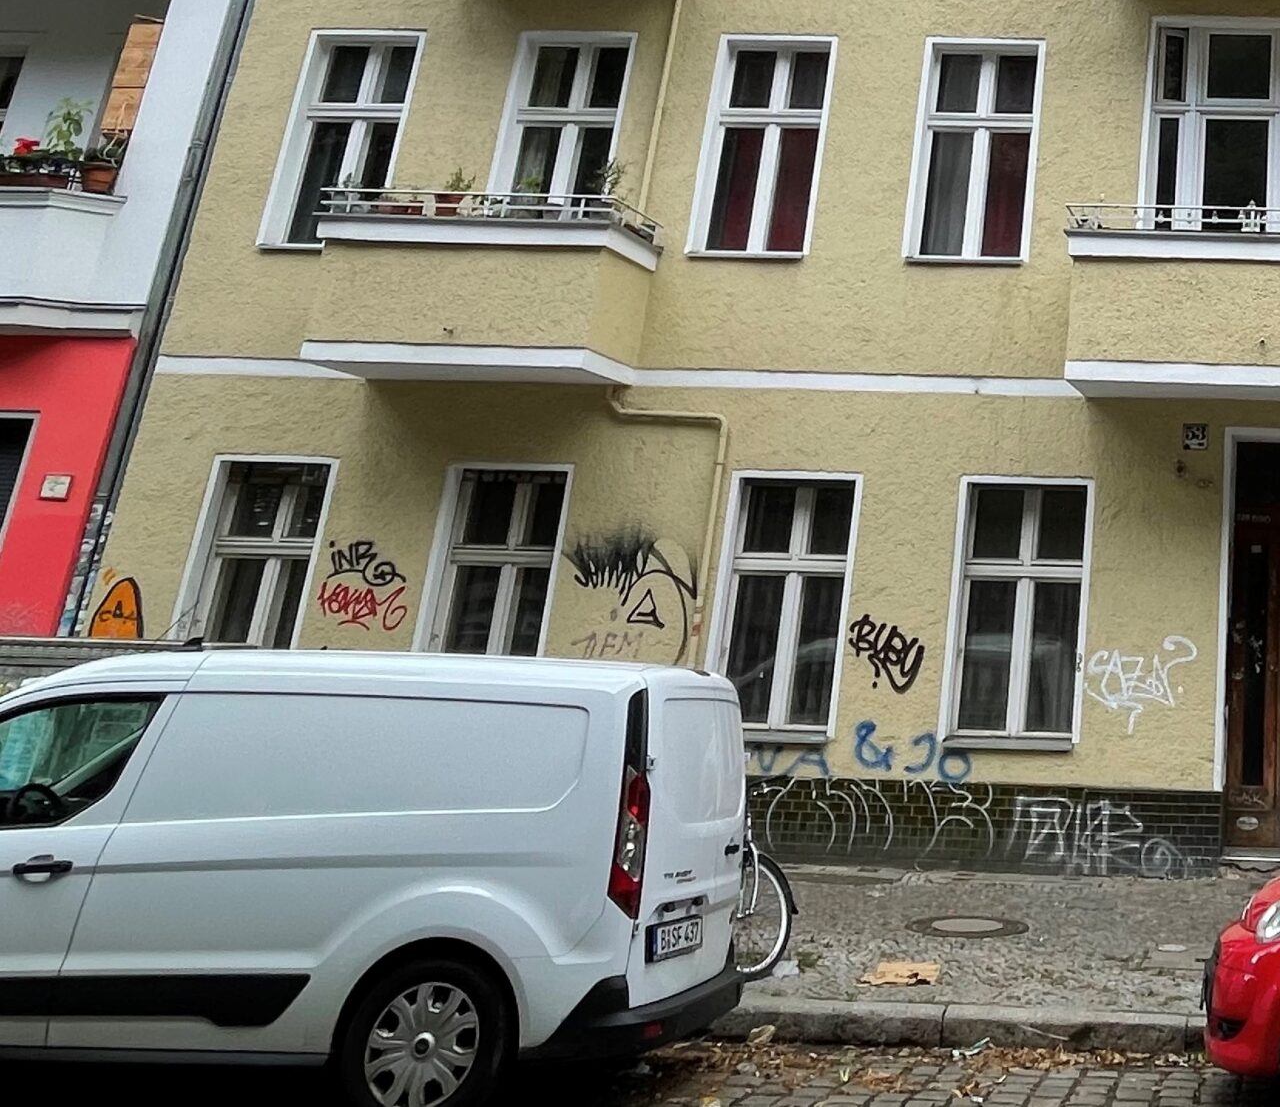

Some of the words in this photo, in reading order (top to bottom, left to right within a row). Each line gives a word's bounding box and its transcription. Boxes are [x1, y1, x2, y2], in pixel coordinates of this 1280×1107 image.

[1185, 425, 1207, 441] 53
[855, 720, 894, 772] &
[661, 929, 667, 951] B
[684, 921, 699, 943] 437
